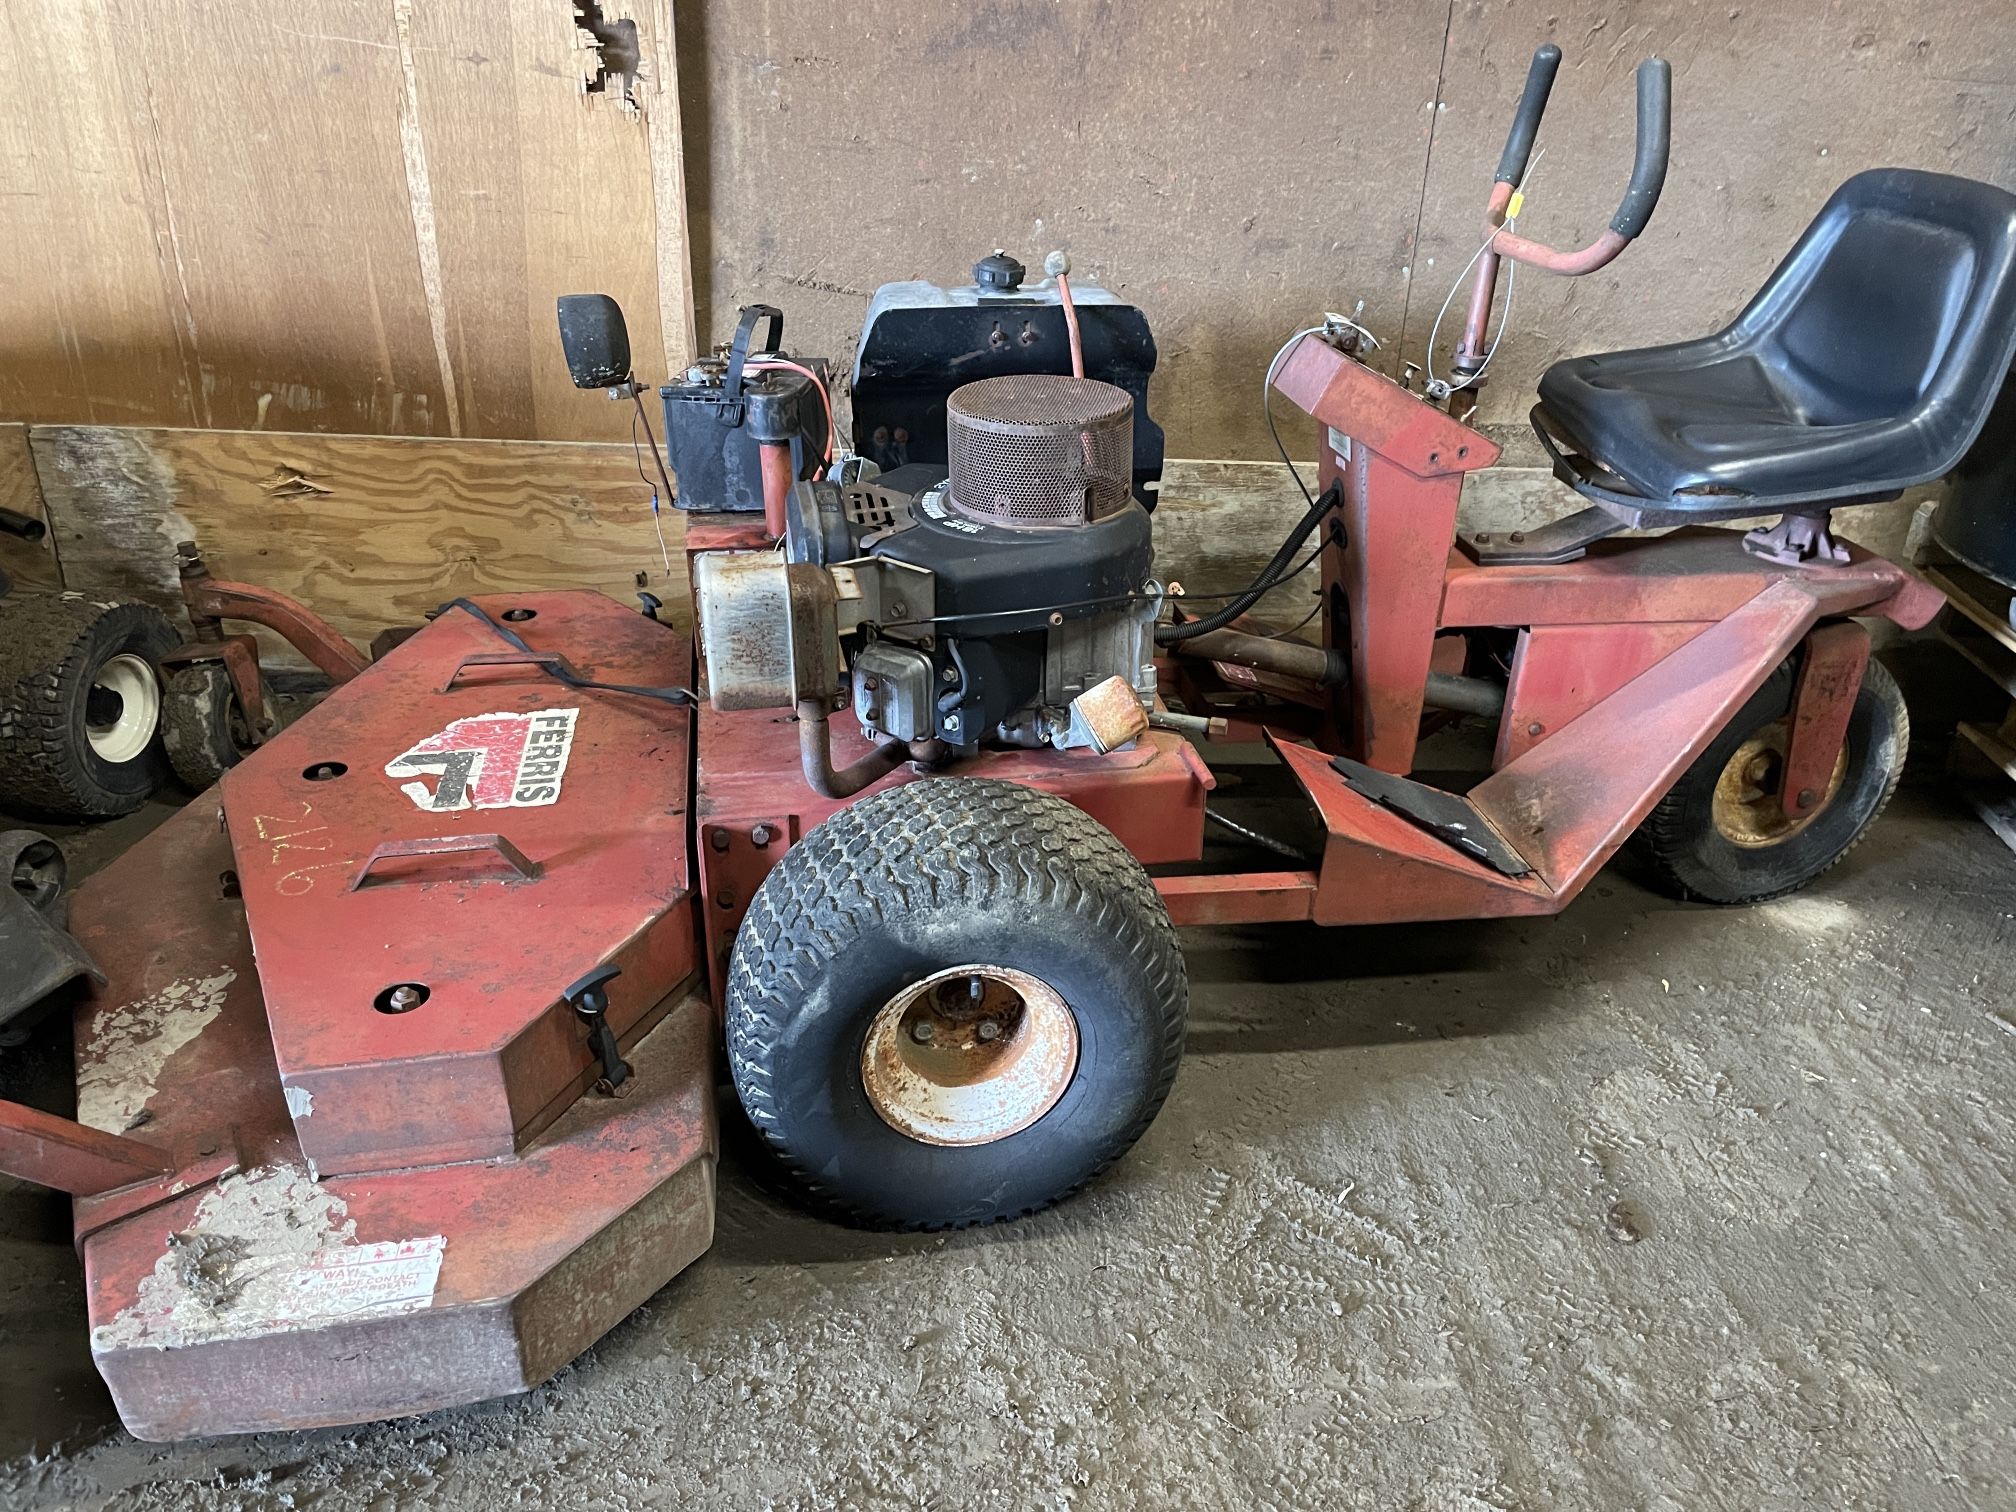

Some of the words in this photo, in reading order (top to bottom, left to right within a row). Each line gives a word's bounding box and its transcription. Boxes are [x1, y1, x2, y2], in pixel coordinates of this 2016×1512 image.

[515, 715, 570, 802] FERRIS
[326, 1279, 364, 1290] BLADE
[366, 1272, 421, 1285] CONTACT
